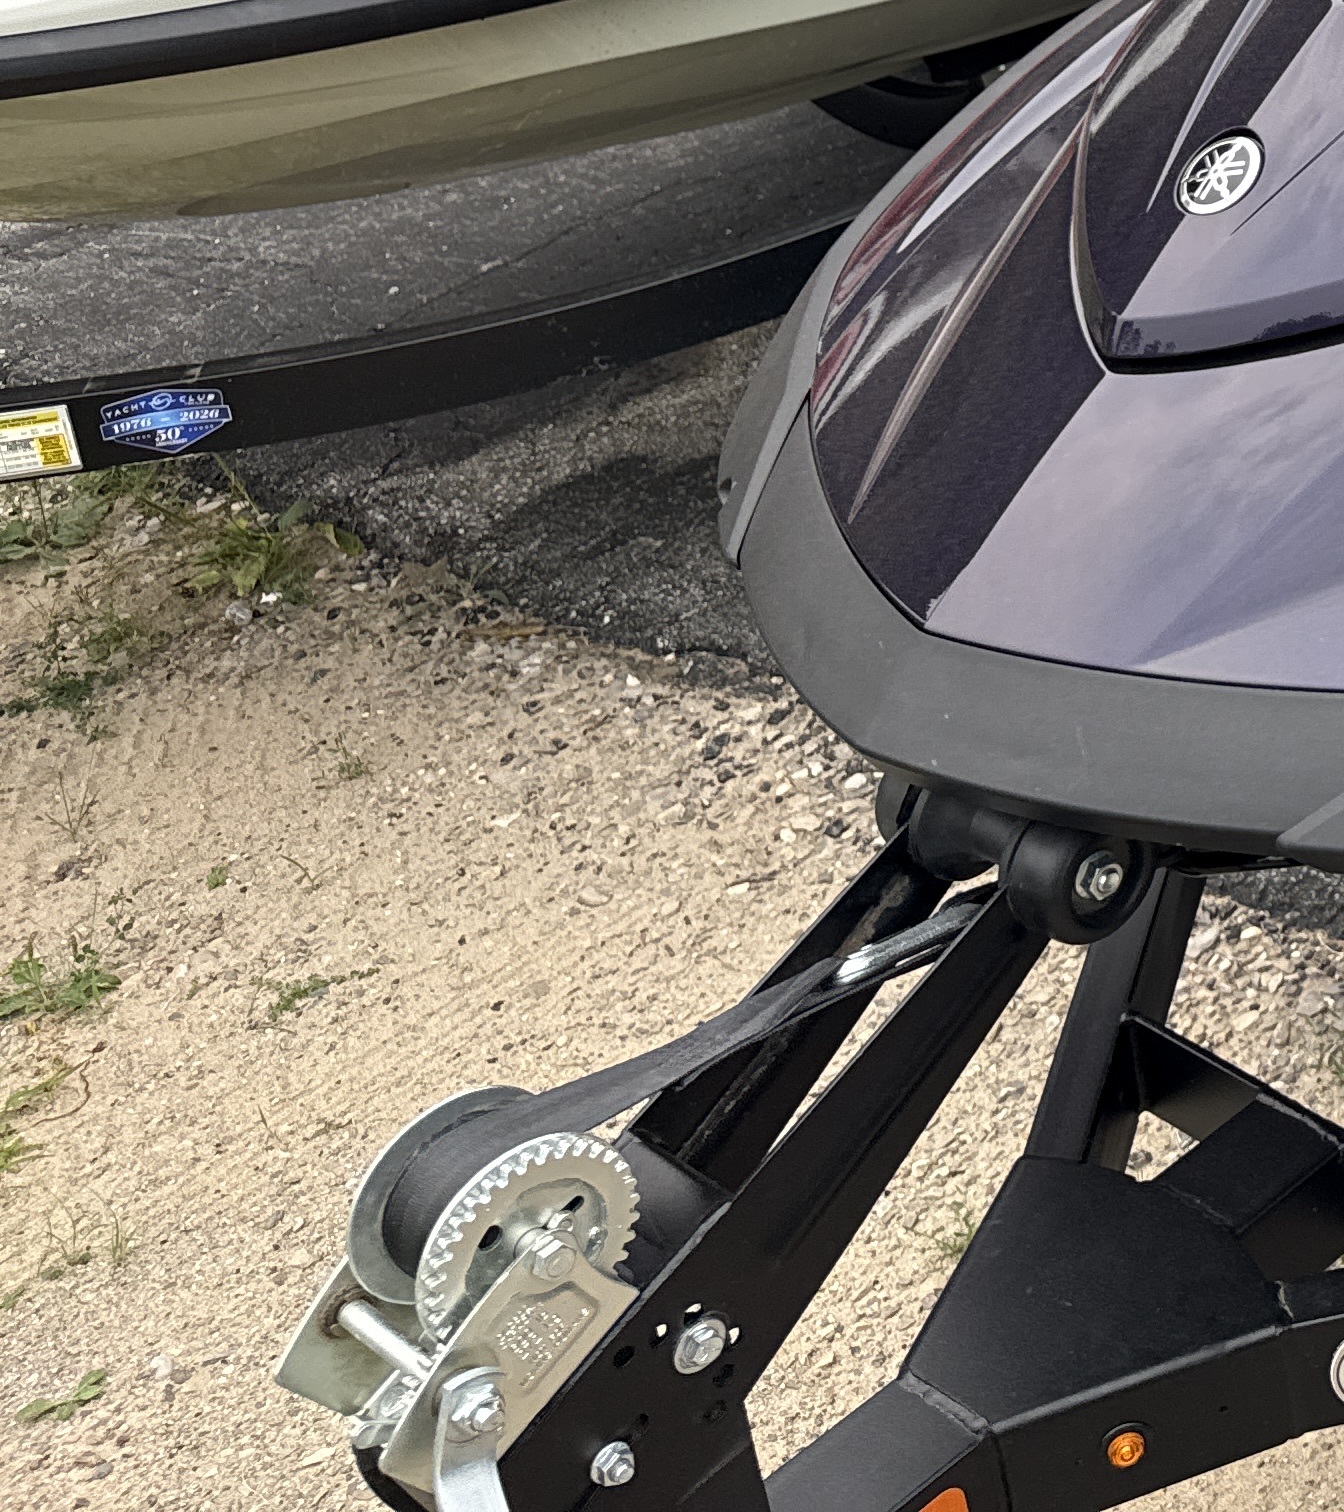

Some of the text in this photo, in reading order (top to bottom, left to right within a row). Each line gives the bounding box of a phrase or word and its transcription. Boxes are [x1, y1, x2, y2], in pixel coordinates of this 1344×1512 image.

[105, 401, 147, 419] YACHT
[112, 417, 152, 434] 1976
[179, 408, 220, 422] 2026
